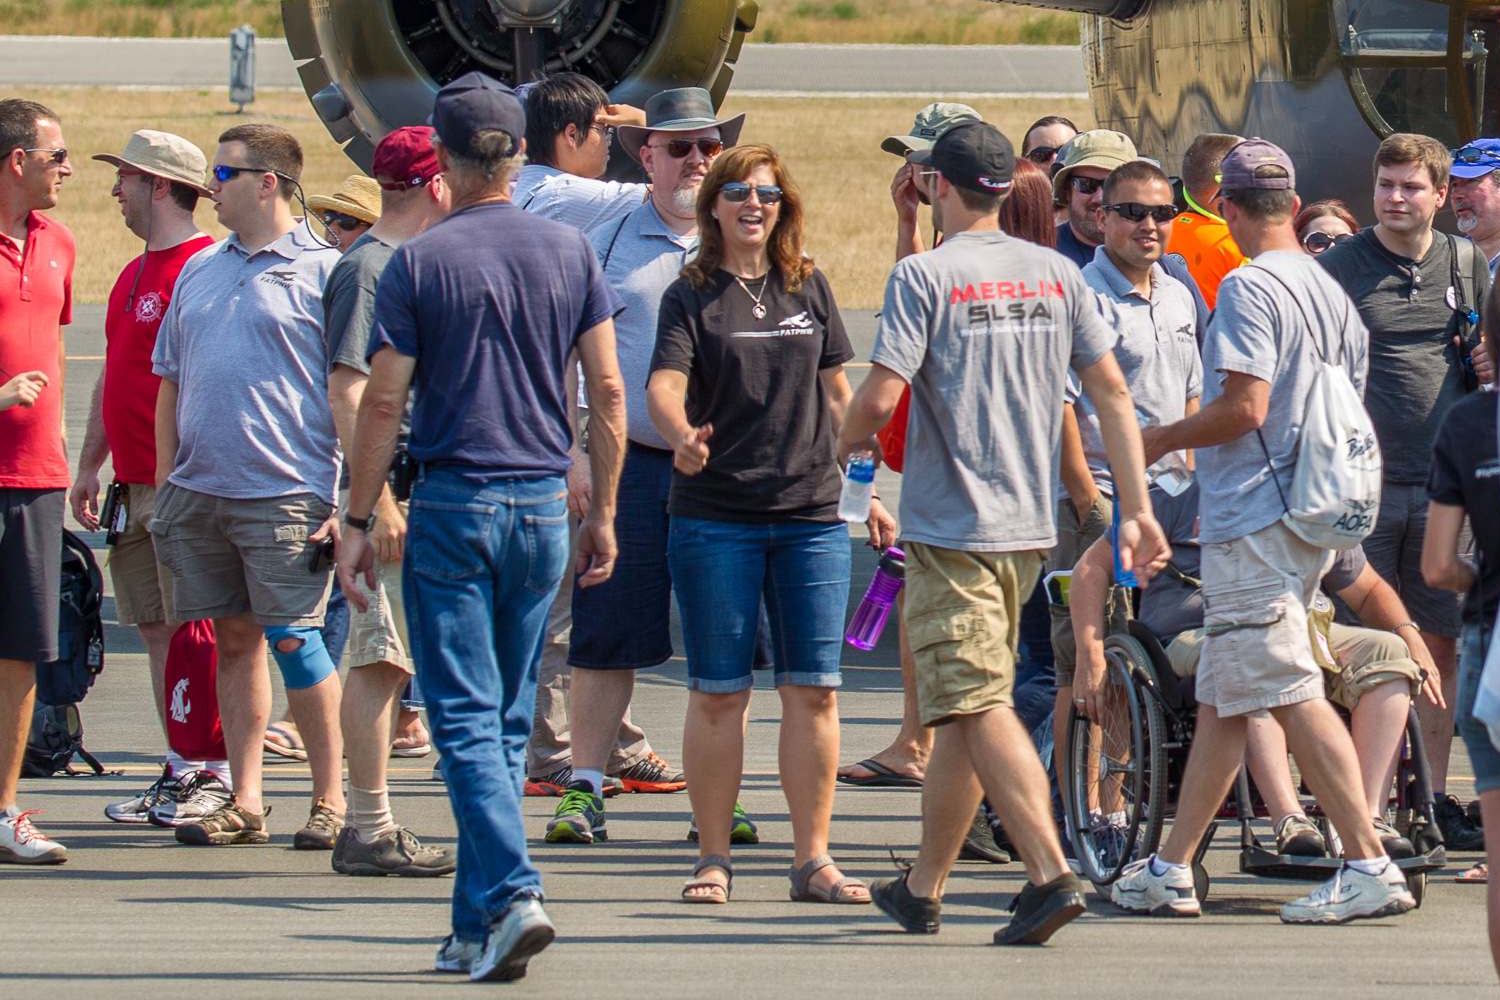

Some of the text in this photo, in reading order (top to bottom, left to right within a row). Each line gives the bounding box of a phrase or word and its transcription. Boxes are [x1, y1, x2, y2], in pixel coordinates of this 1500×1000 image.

[260, 276, 292, 289] FATPNW
[950, 280, 1064, 305] MERLIN
[968, 301, 1052, 324] SLSA
[780, 328, 814, 337] FATPNW
[1332, 512, 1372, 532] AOPA
